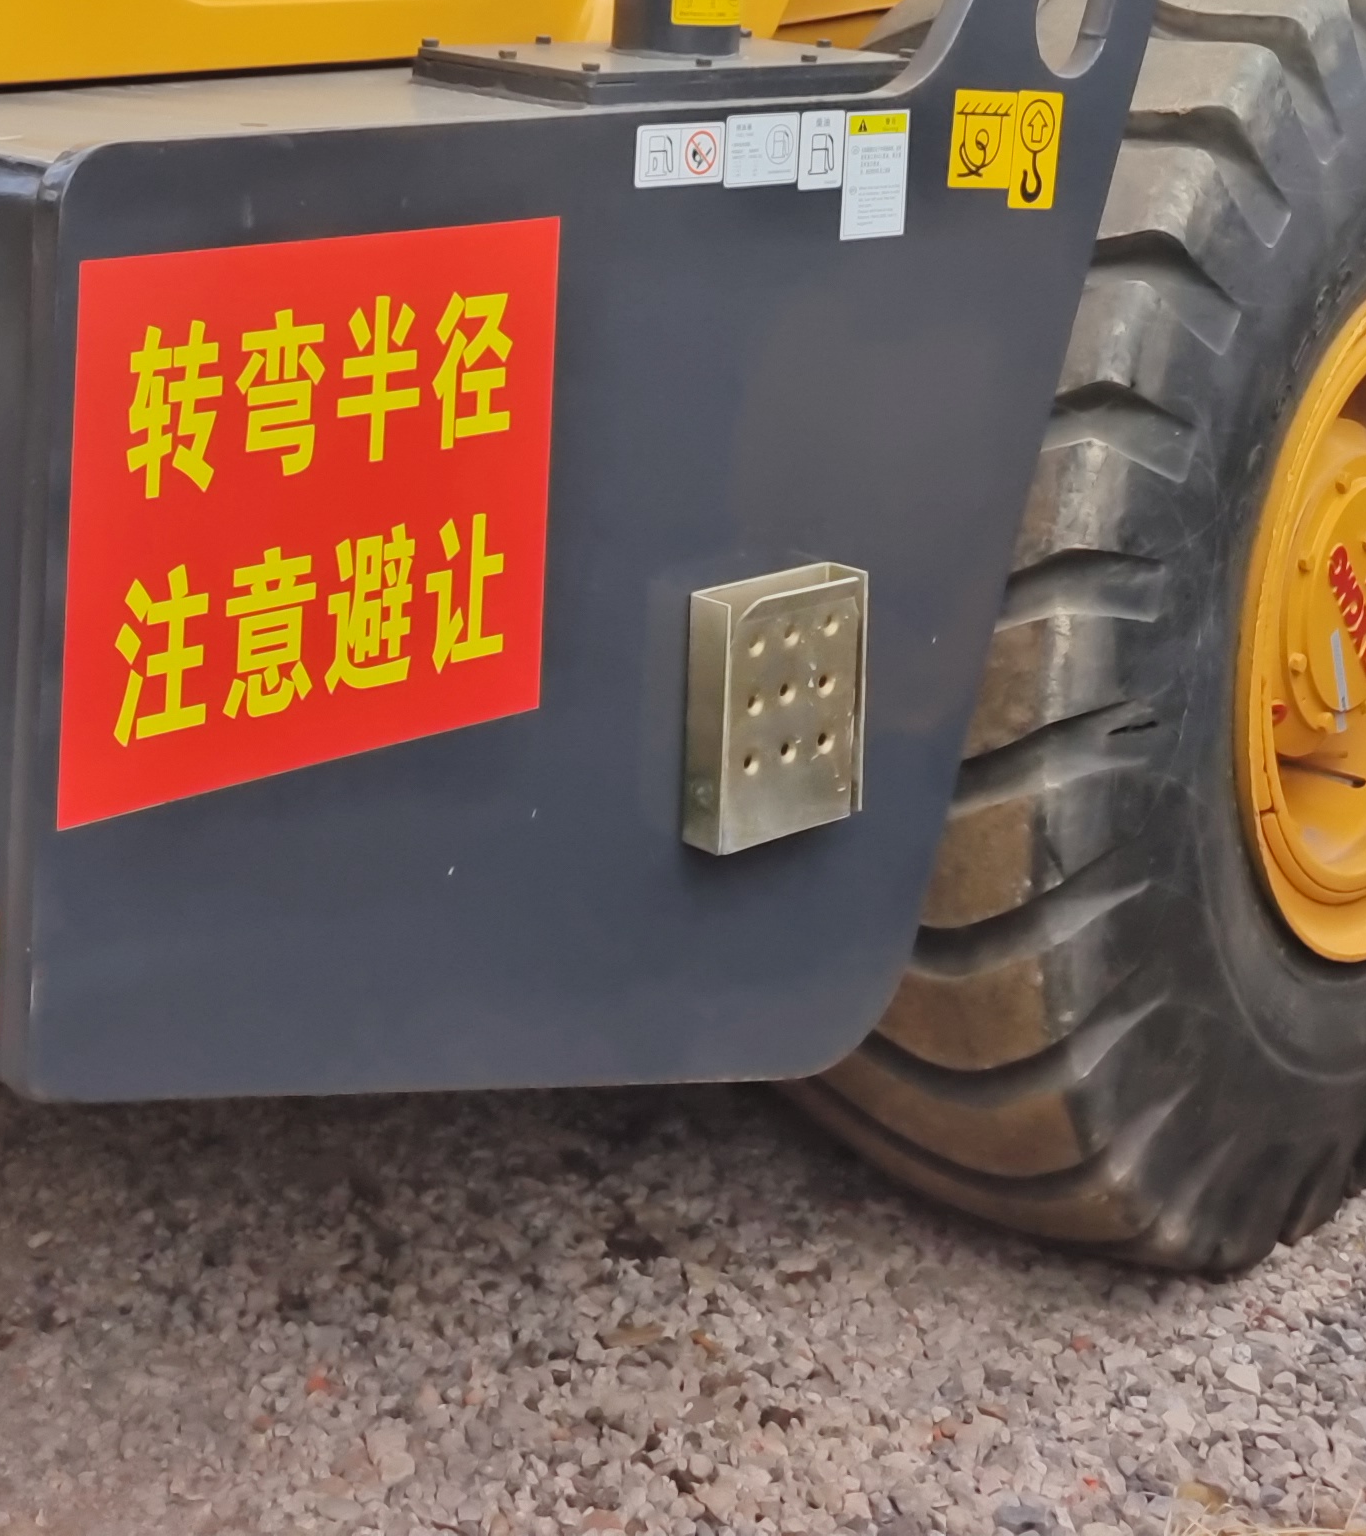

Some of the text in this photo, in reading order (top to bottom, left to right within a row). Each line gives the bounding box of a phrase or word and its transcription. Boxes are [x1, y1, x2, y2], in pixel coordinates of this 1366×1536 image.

[126, 291, 514, 500] 转弯半径
[112, 512, 505, 748] 注意避让
